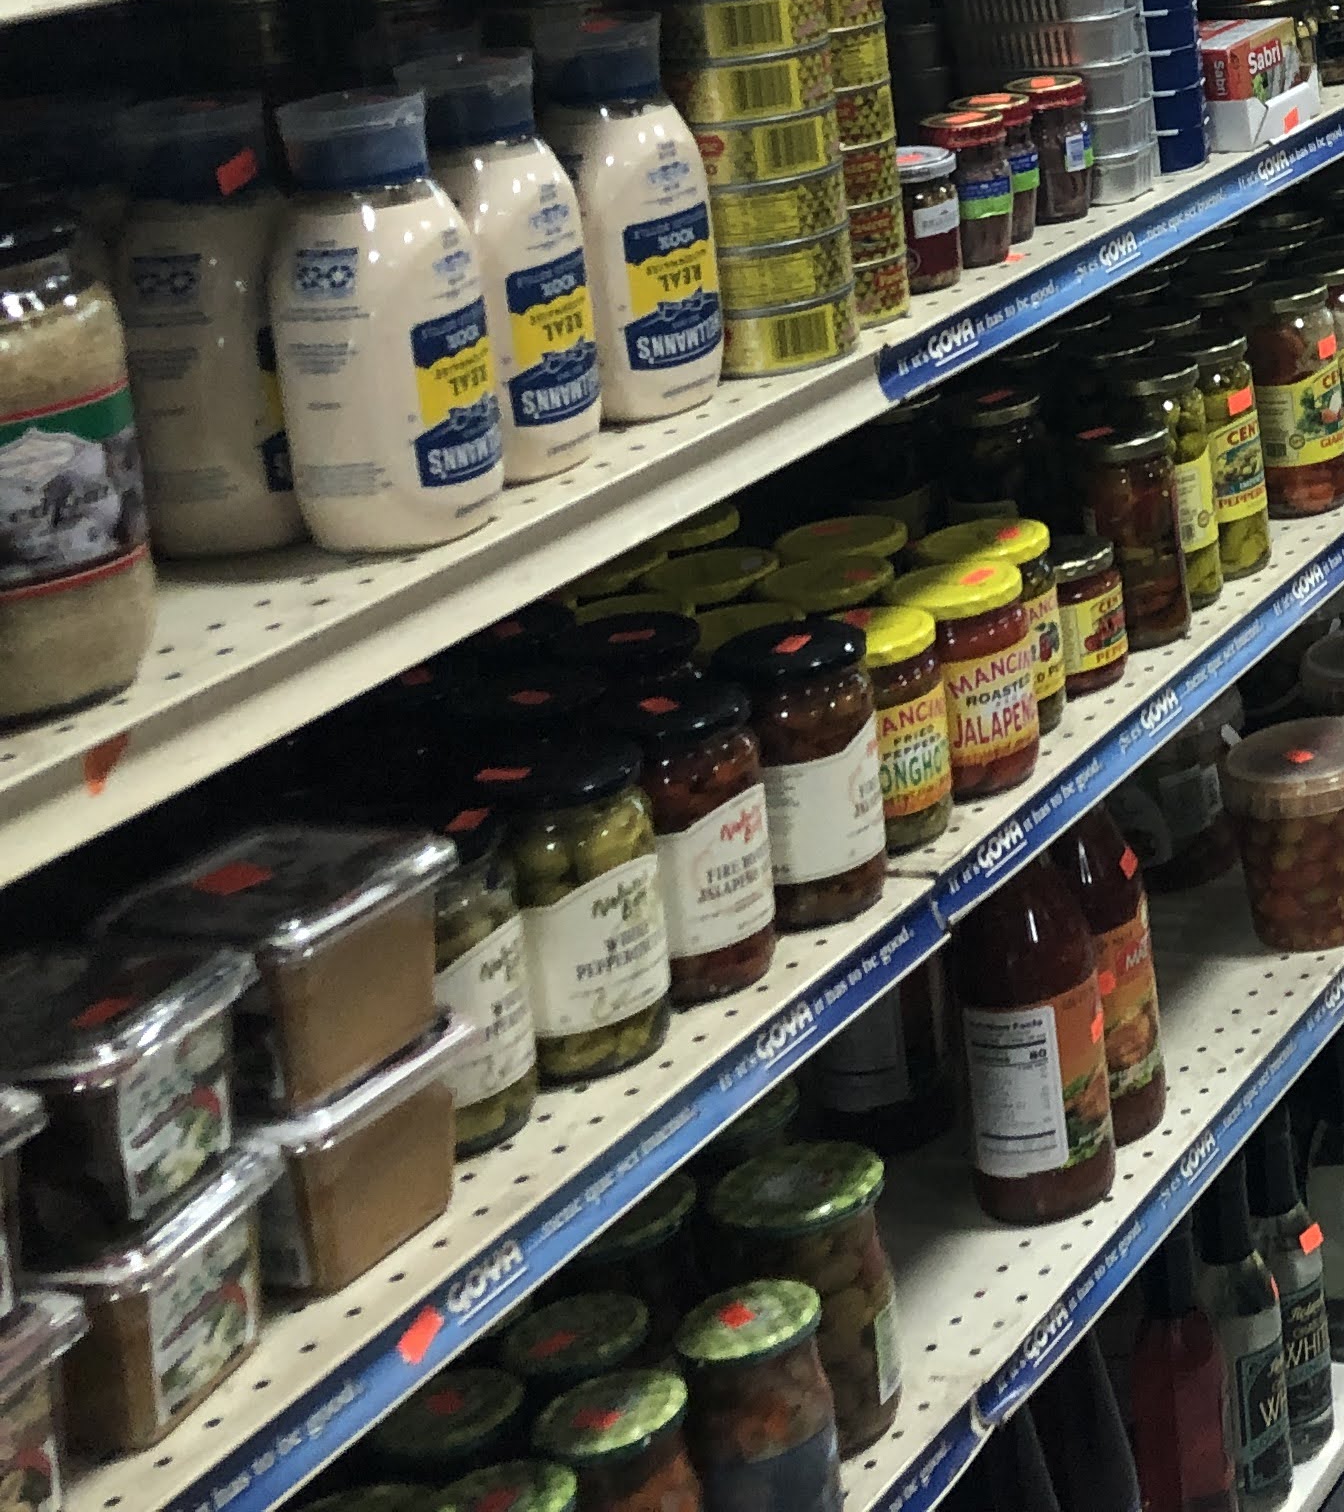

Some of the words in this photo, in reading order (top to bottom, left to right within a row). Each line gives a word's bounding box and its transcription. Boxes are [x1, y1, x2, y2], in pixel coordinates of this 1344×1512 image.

[1214, 60, 1225, 96] Sabri
[1248, 39, 1281, 76] Sabri
[1257, 151, 1291, 182] GOYA
[1100, 231, 1138, 269] GOYA
[928, 319, 976, 360] GOYA
[987, 310, 1004, 330] has
[1292, 563, 1324, 599] GOYA
[1140, 688, 1179, 732] GOYA
[976, 817, 1026, 869] GOYA
[755, 999, 815, 1061] GOYA
[825, 979, 848, 1007] has
[862, 955, 879, 978] be
[1179, 1133, 1217, 1181] GOYA
[446, 1240, 524, 1314] GOYA
[1023, 1301, 1070, 1362] GOYA
